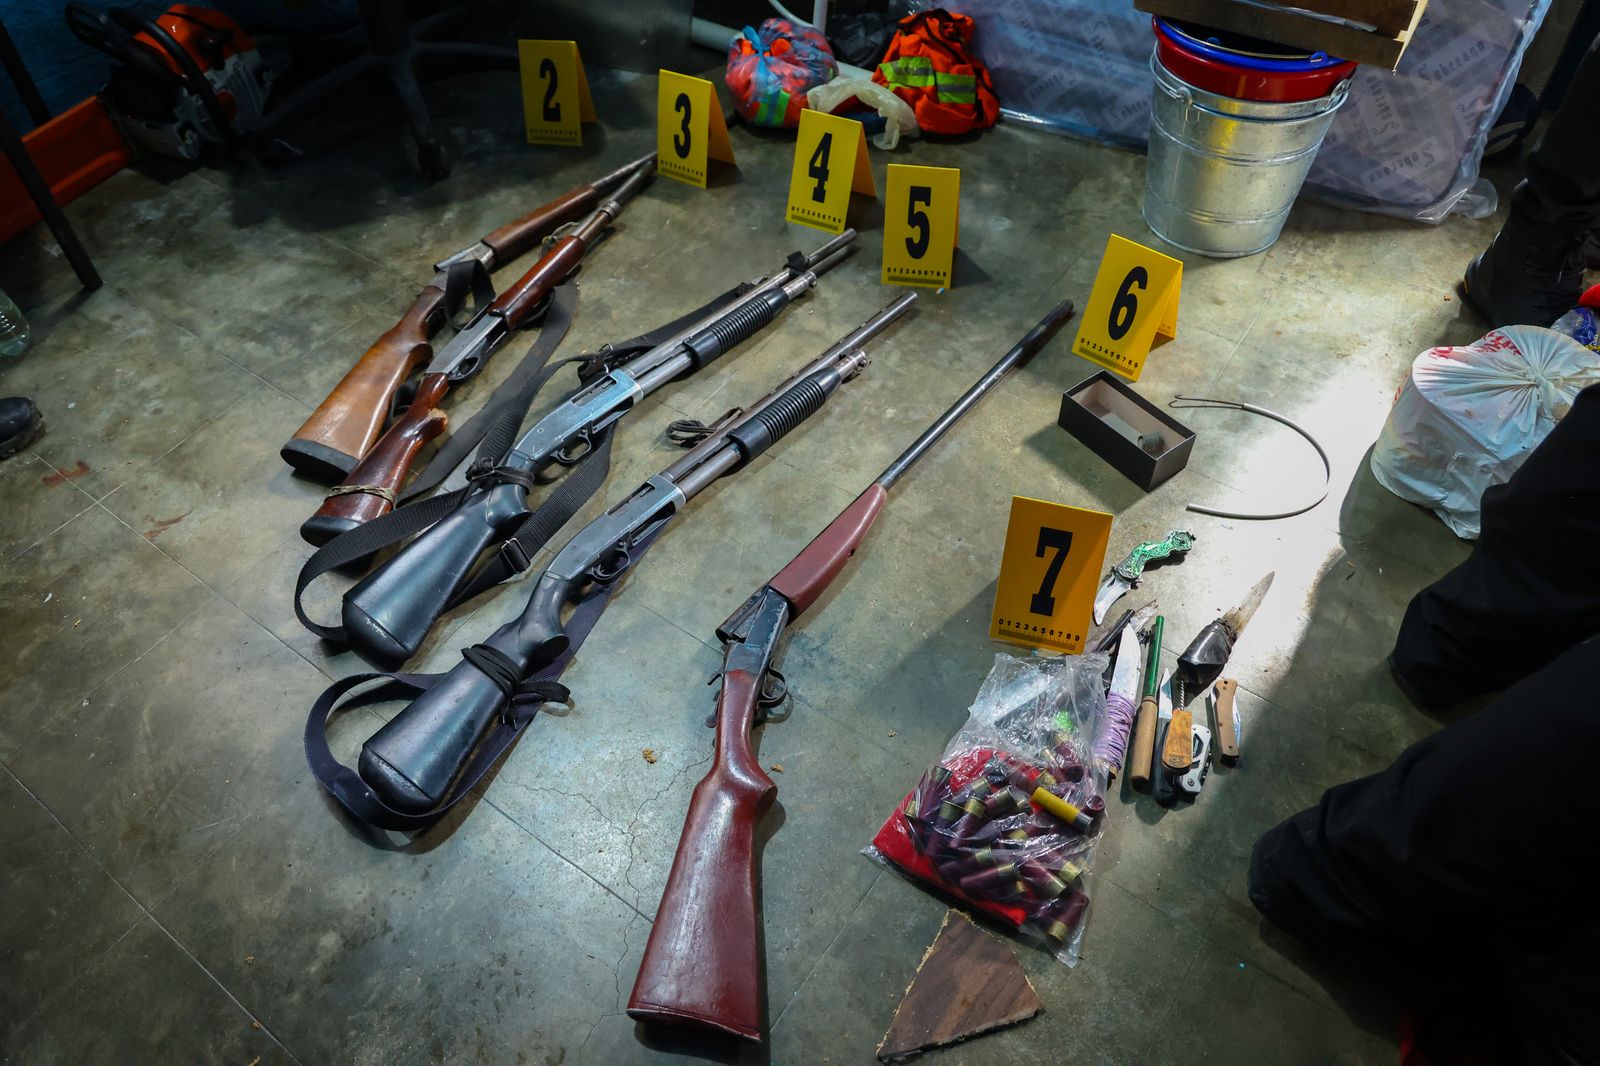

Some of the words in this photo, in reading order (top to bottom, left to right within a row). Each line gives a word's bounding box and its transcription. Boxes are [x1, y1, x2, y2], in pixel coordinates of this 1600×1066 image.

[540, 58, 561, 122] 2
[1418, 40, 1486, 90] Soberano
[674, 92, 692, 159] 3
[808, 131, 833, 204] 4
[905, 185, 932, 260] 5
[1108, 266, 1149, 341] 6
[1029, 526, 1073, 617] 7
